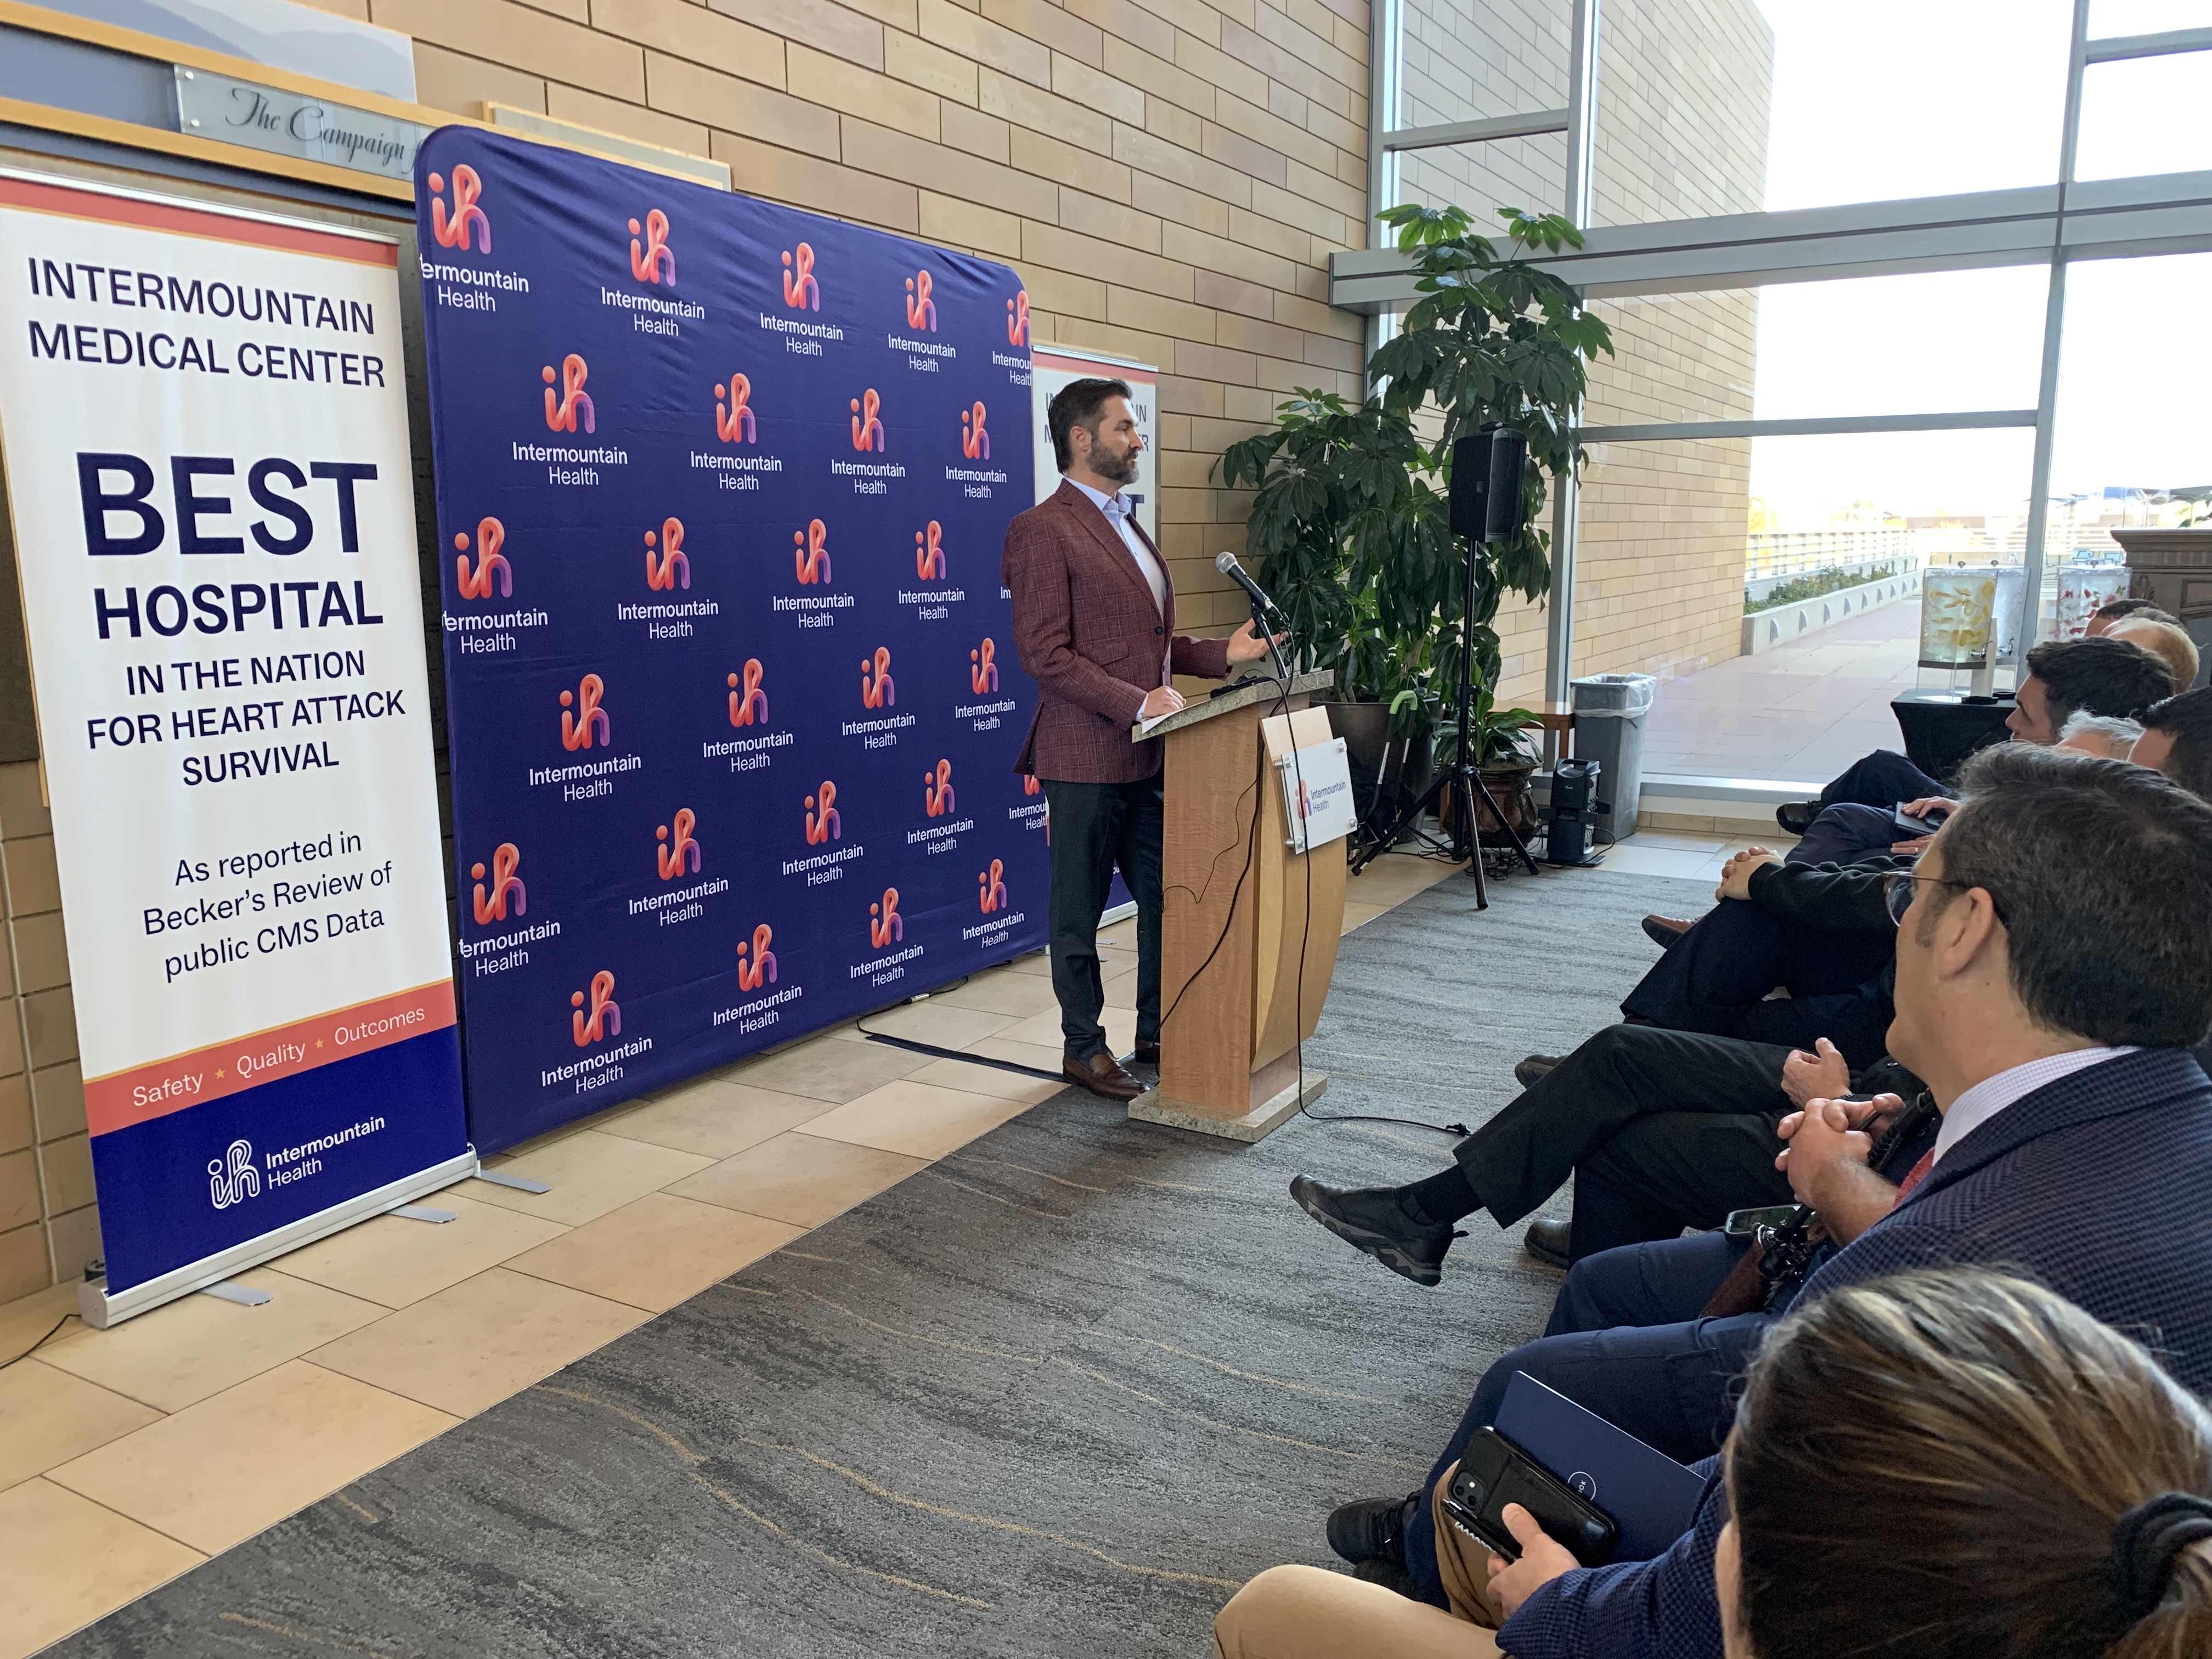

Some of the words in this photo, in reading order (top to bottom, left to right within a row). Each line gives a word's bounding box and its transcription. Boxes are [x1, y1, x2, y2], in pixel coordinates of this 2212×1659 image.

[225, 87, 281, 131] The
[289, 106, 405, 166] Campaign
[28, 257, 375, 335] INTERMOUNTAIN
[438, 285, 495, 312] Health
[602, 287, 705, 319] Intermountain
[634, 314, 679, 336] Health
[760, 312, 843, 341] Intermountain
[28, 320, 229, 374] MEDICAL
[238, 342, 385, 387] CENTER
[786, 336, 822, 356] Health
[888, 334, 956, 358] Intermountain
[909, 355, 939, 373] Health
[992, 351, 1031, 370] Intermou
[512, 442, 628, 465] Intermountain
[691, 451, 782, 472] Intermountain
[549, 466, 599, 485] Health
[831, 459, 905, 477] Intermountain
[946, 466, 1007, 483] Intermountain
[719, 472, 759, 490] Health
[854, 478, 887, 494] Health
[964, 483, 991, 498] Health
[76, 452, 378, 556] BEST
[773, 592, 854, 612] Intermountain
[898, 588, 964, 605] Intermountain
[94, 580, 383, 639] HOSPITAL
[618, 599, 719, 620] Intermountain
[798, 611, 833, 629] Health
[918, 605, 948, 620] Health
[649, 622, 693, 639] Health
[461, 633, 516, 654] Health
[127, 664, 164, 695] IN
[171, 659, 242, 691] THE
[251, 650, 365, 685] NATION
[87, 713, 162, 749] FOR
[171, 701, 284, 740] HEART
[291, 690, 406, 727] ATTACK
[955, 699, 1015, 719] Intermountain
[842, 713, 916, 736] Intermountain
[973, 716, 1000, 731] Health
[703, 731, 793, 758] Intermountain
[864, 732, 896, 750] Health
[183, 741, 340, 786] SURVIVAL
[529, 753, 641, 786] Intermountain
[730, 753, 770, 773] Health
[563, 778, 612, 802] Health
[1311, 779, 1346, 800] Intermountain
[1009, 803, 1046, 820] Intermou
[1312, 799, 1329, 813] Health
[907, 817, 974, 844] Intermountain
[927, 837, 957, 855] Health
[174, 859, 210, 886] As
[218, 833, 332, 878] reported
[340, 831, 362, 855] in
[782, 844, 863, 876] Intermountain
[807, 866, 843, 887] Health
[143, 889, 266, 935] Becker's
[273, 871, 364, 908] Review
[371, 861, 393, 885] of
[629, 877, 729, 915] Intermountain
[659, 902, 703, 926] Health
[963, 911, 1024, 940] Intermountain
[165, 938, 250, 983] public
[257, 918, 319, 954] CMS
[326, 907, 385, 938] Data
[981, 930, 1008, 949] Health
[476, 949, 529, 977] Health
[850, 944, 923, 979] Intermountain
[872, 966, 904, 988] Health
[713, 985, 802, 1026] Intermountain
[740, 1009, 779, 1035] Health
[133, 1072, 204, 1107] Safety
[236, 1041, 306, 1079] Quality
[334, 1007, 425, 1046] Outcomes
[541, 1037, 652, 1087] Intermountain
[575, 1064, 623, 1094] Health
[266, 1115, 385, 1169] Intermountain
[268, 1158, 323, 1189] Health
